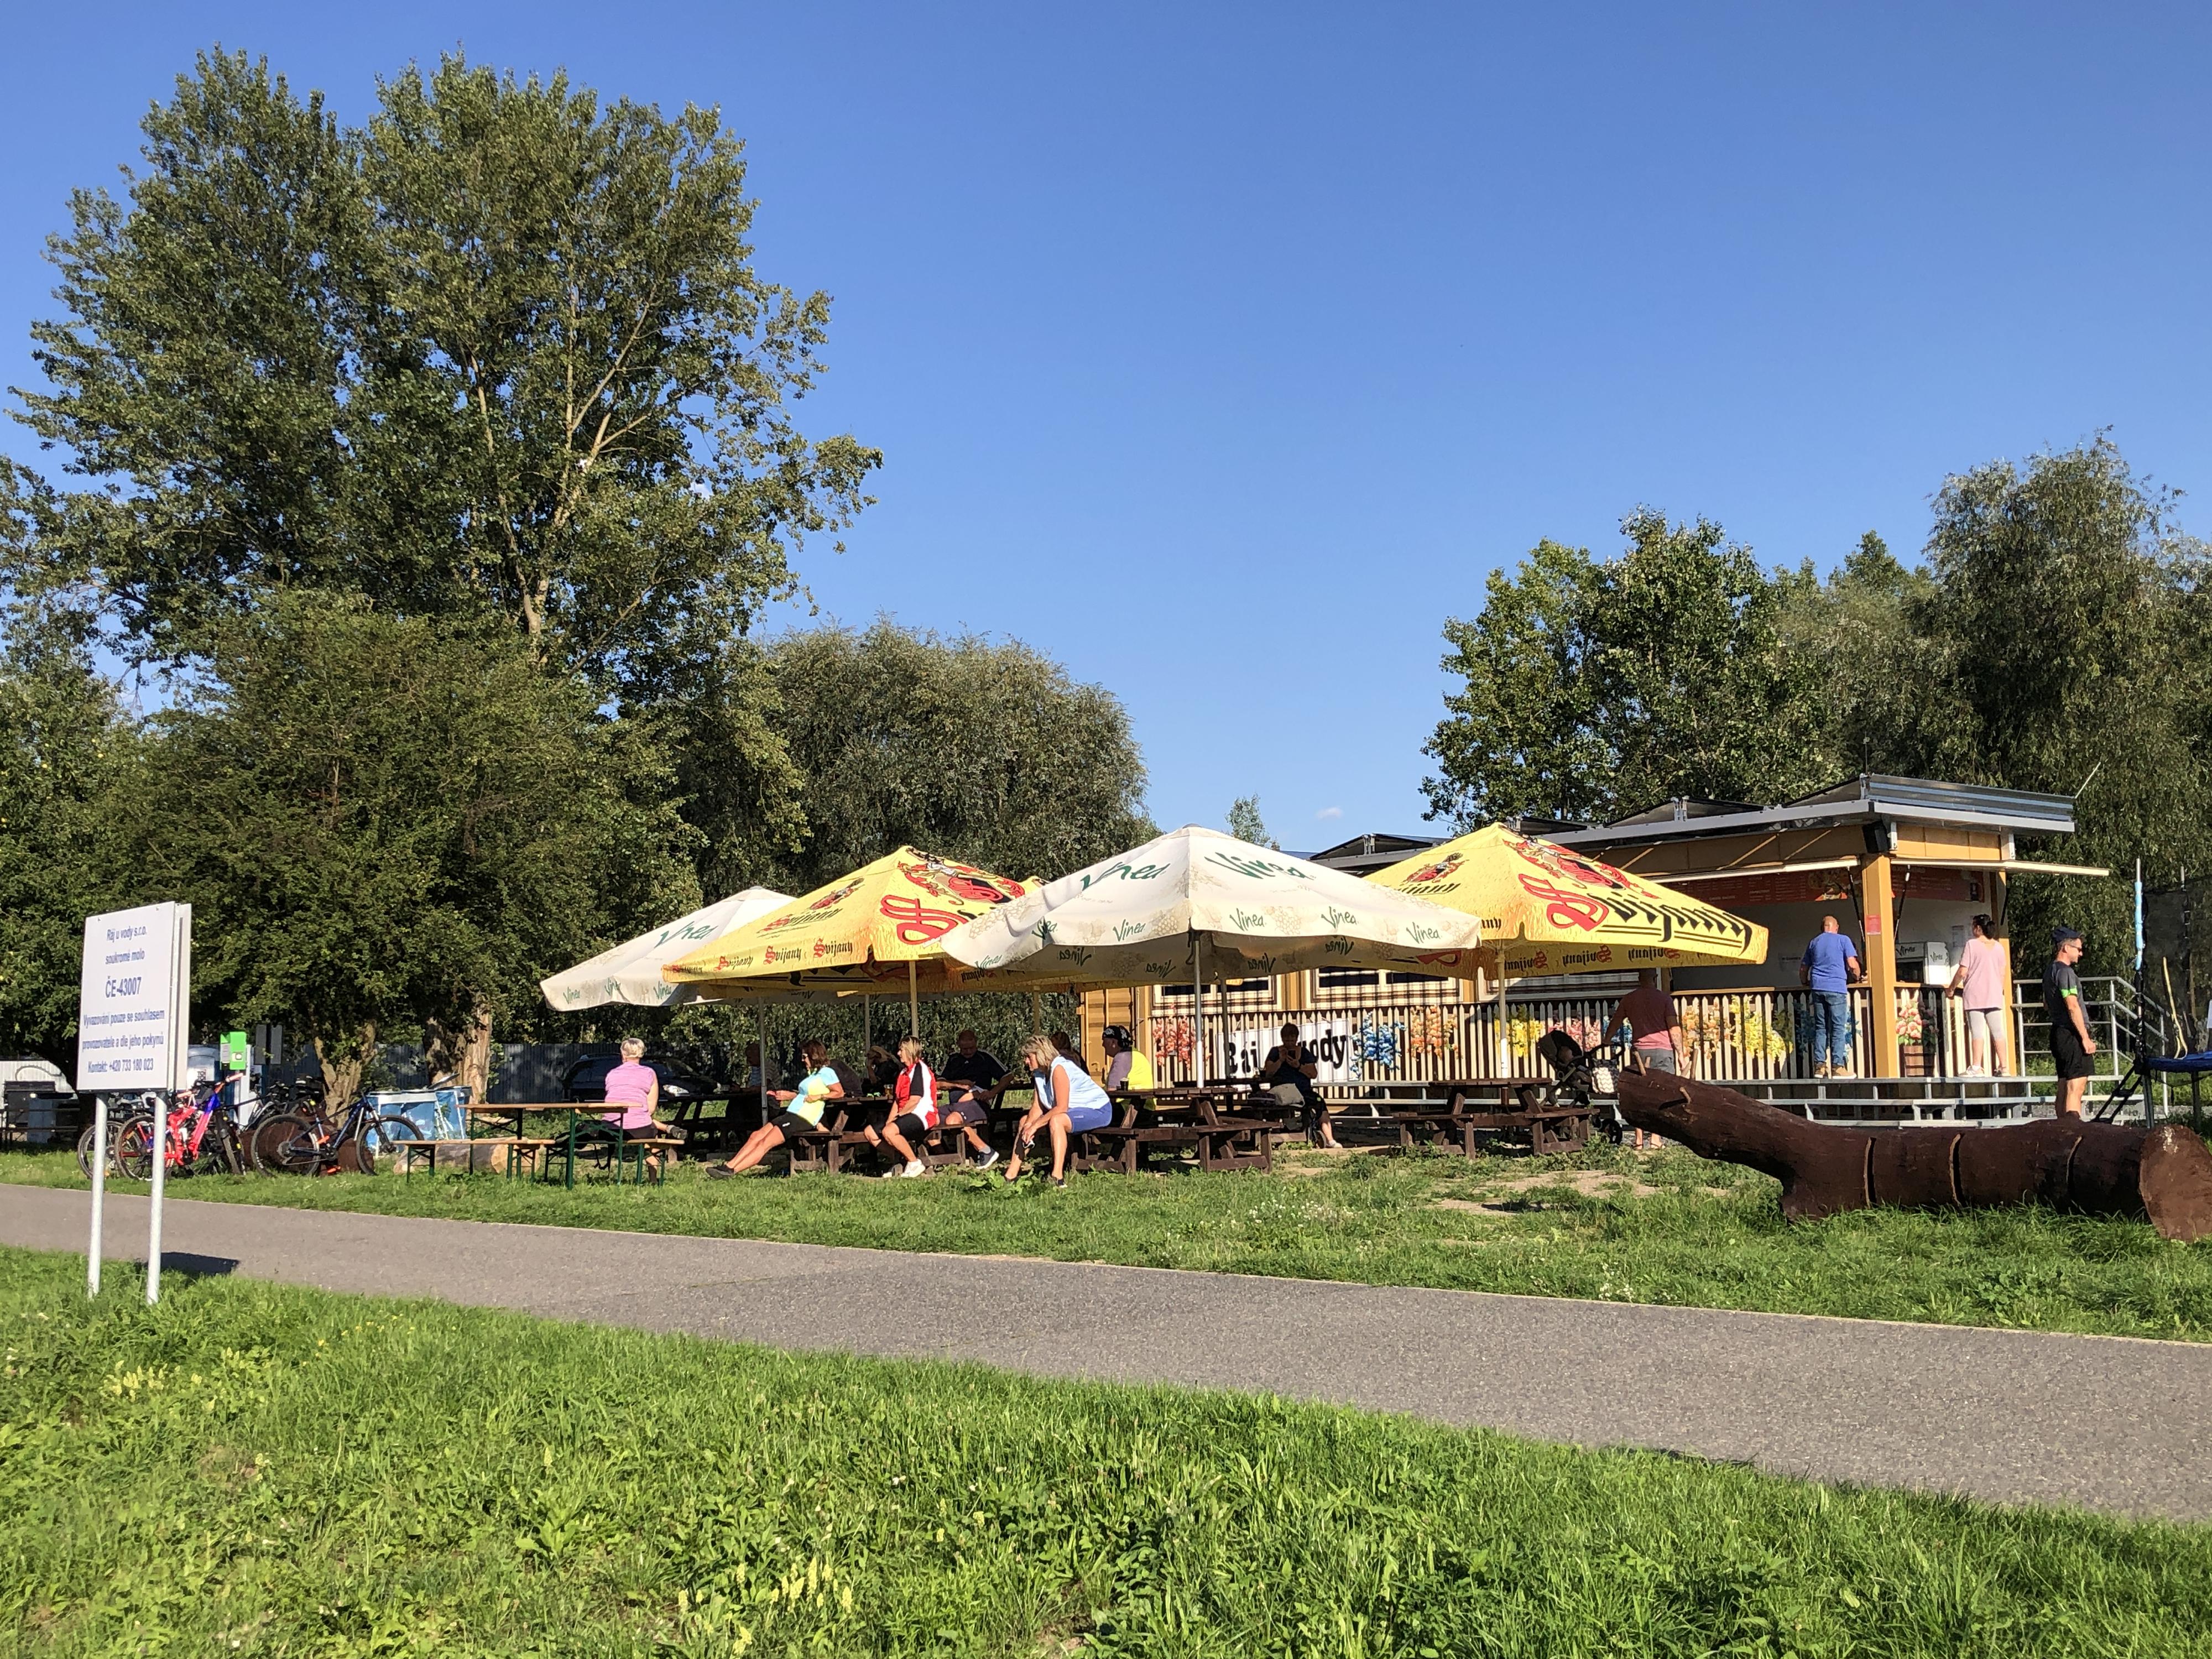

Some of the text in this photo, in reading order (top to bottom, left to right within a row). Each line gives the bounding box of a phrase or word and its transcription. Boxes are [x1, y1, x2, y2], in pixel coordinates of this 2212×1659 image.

[1081, 862, 1171, 891] Vinea
[1204, 852, 1314, 880] Vinea
[1229, 908, 1265, 931] Vinea
[1322, 906, 1357, 929] Vinea
[1517, 873, 1752, 956] Svijany
[116, 931, 119, 940] u
[121, 925, 133, 940] vody
[1113, 919, 1146, 941] Vinea
[1406, 922, 1441, 944] Vinea
[132, 948, 145, 961] molo
[764, 946, 802, 965] Svijany
[813, 938, 853, 958] Svijany
[106, 975, 142, 998] ČE-43007
[653, 980, 671, 1000] Vinea
[111, 1013, 126, 1026] pouze
[127, 1013, 133, 1022] se
[134, 1008, 165, 1022] souhlasem
[116, 1038, 119, 1047] a
[128, 1034, 141, 1050] jeho
[1297, 1029, 1347, 1070] ody
[109, 1060, 121, 1072] +420
